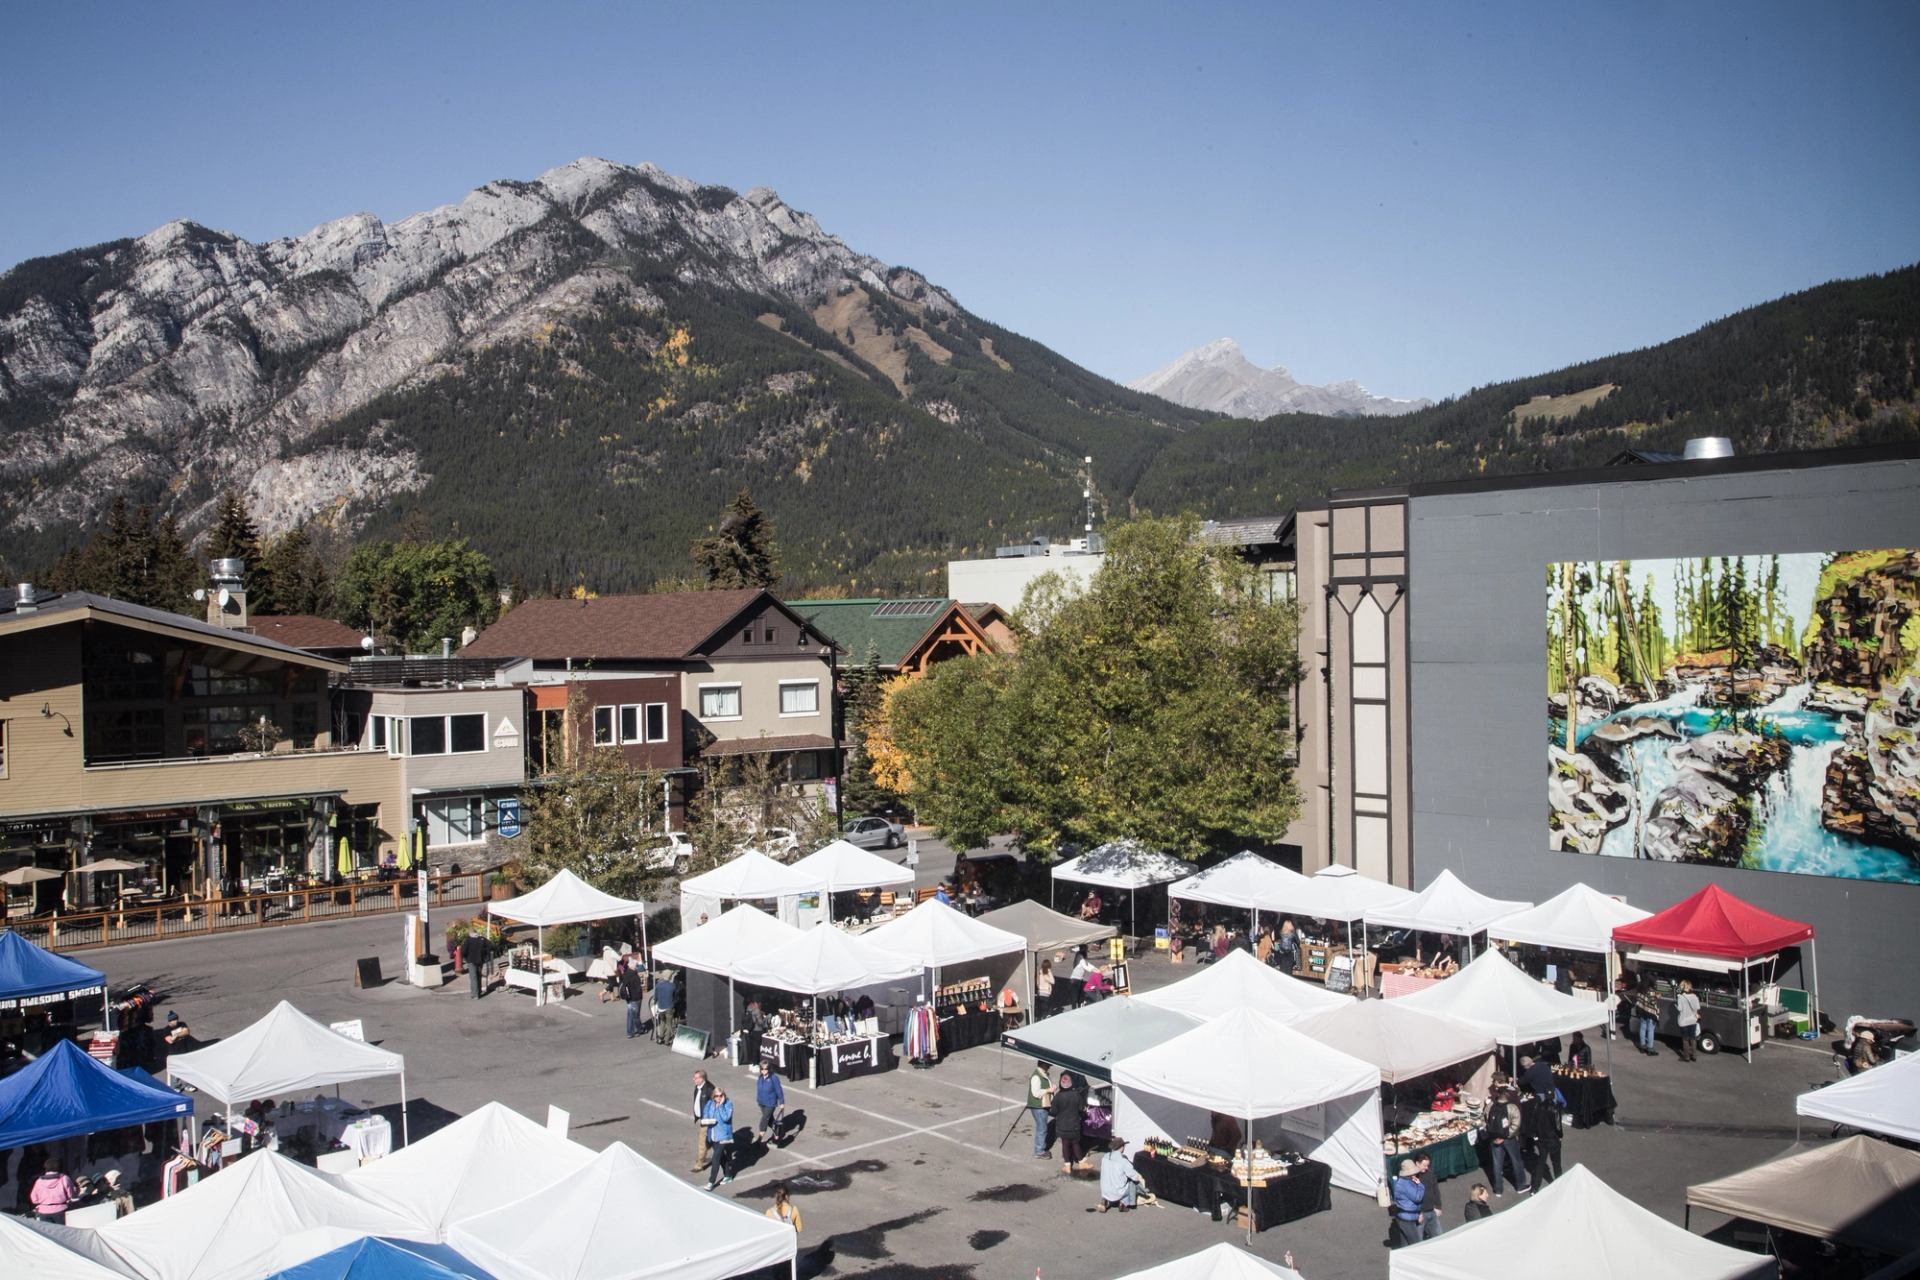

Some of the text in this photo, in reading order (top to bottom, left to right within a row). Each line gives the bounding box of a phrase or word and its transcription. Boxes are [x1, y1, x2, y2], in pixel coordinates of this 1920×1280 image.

[20, 992, 66, 1007] AWESOME
[68, 985, 102, 1000] SHIRTS
[839, 1051, 862, 1063] anne
